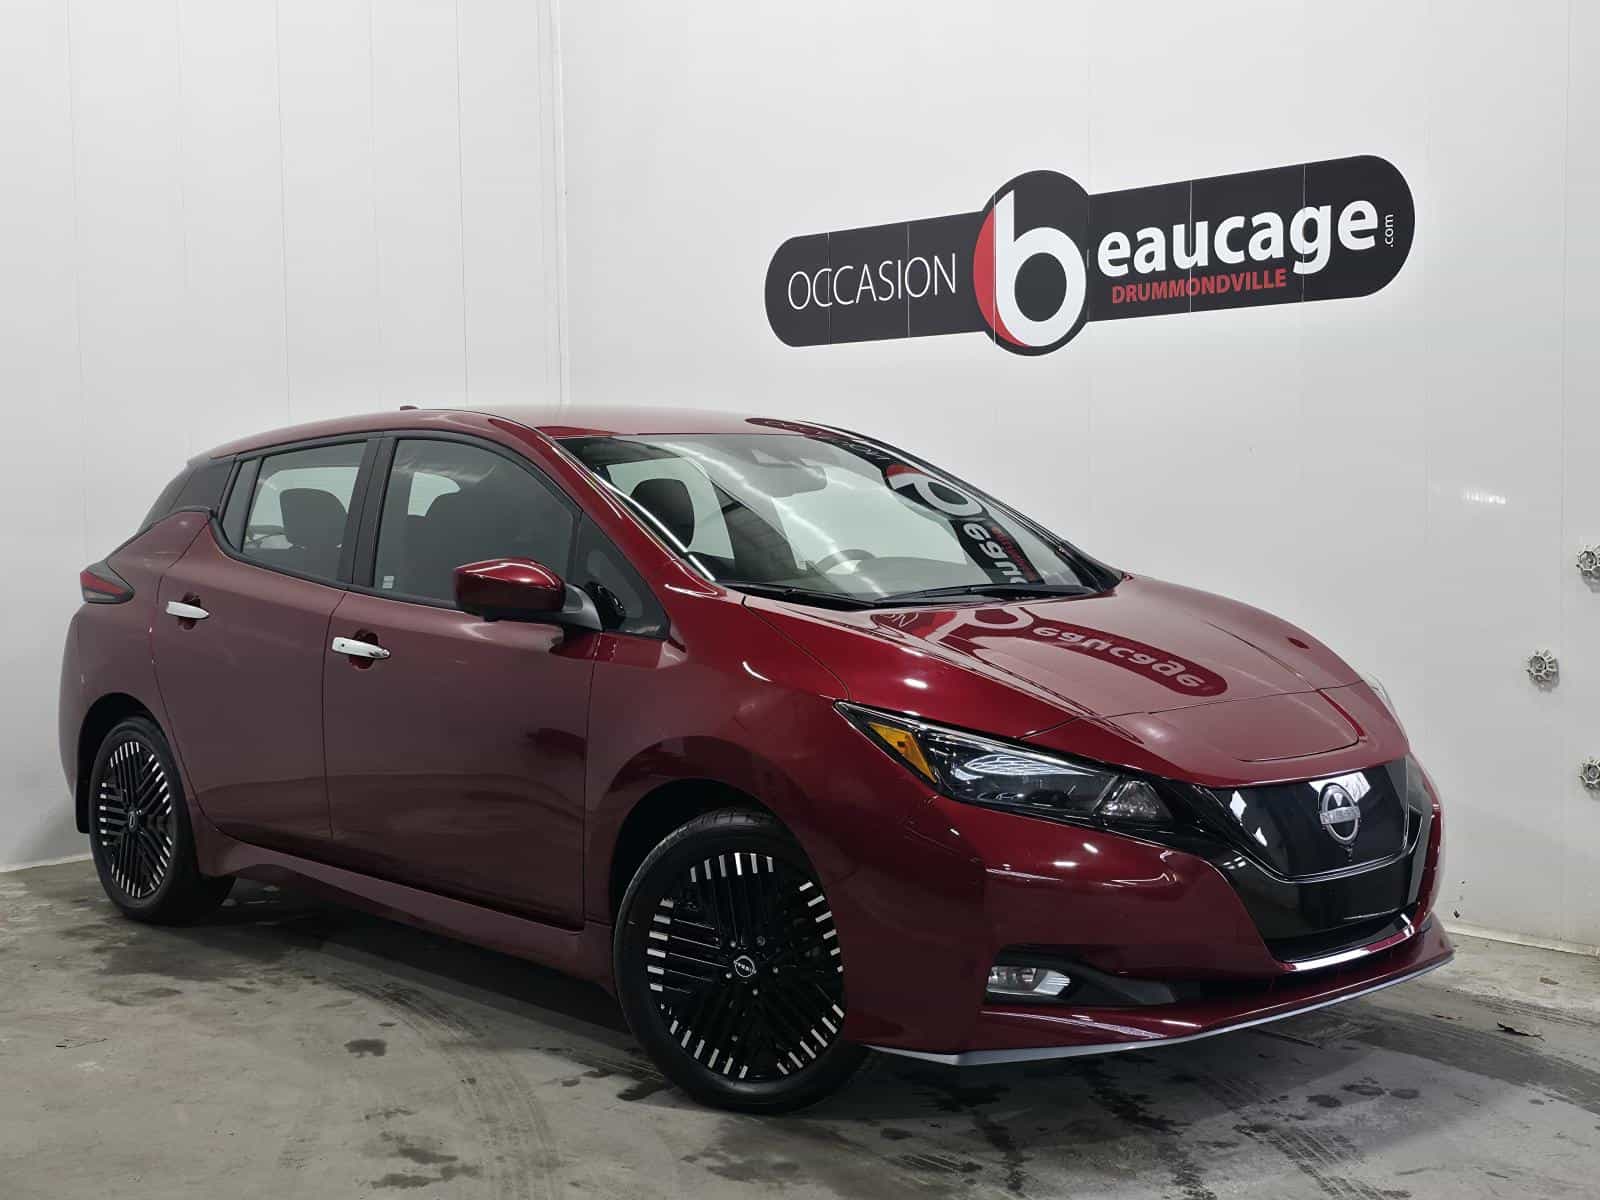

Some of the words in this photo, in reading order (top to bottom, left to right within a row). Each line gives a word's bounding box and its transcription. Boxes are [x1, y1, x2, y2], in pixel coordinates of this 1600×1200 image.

[788, 253, 956, 310] OCCASION
[1383, 214, 1394, 248] .com
[1111, 268, 1288, 304] DRUMMONDVILLE
